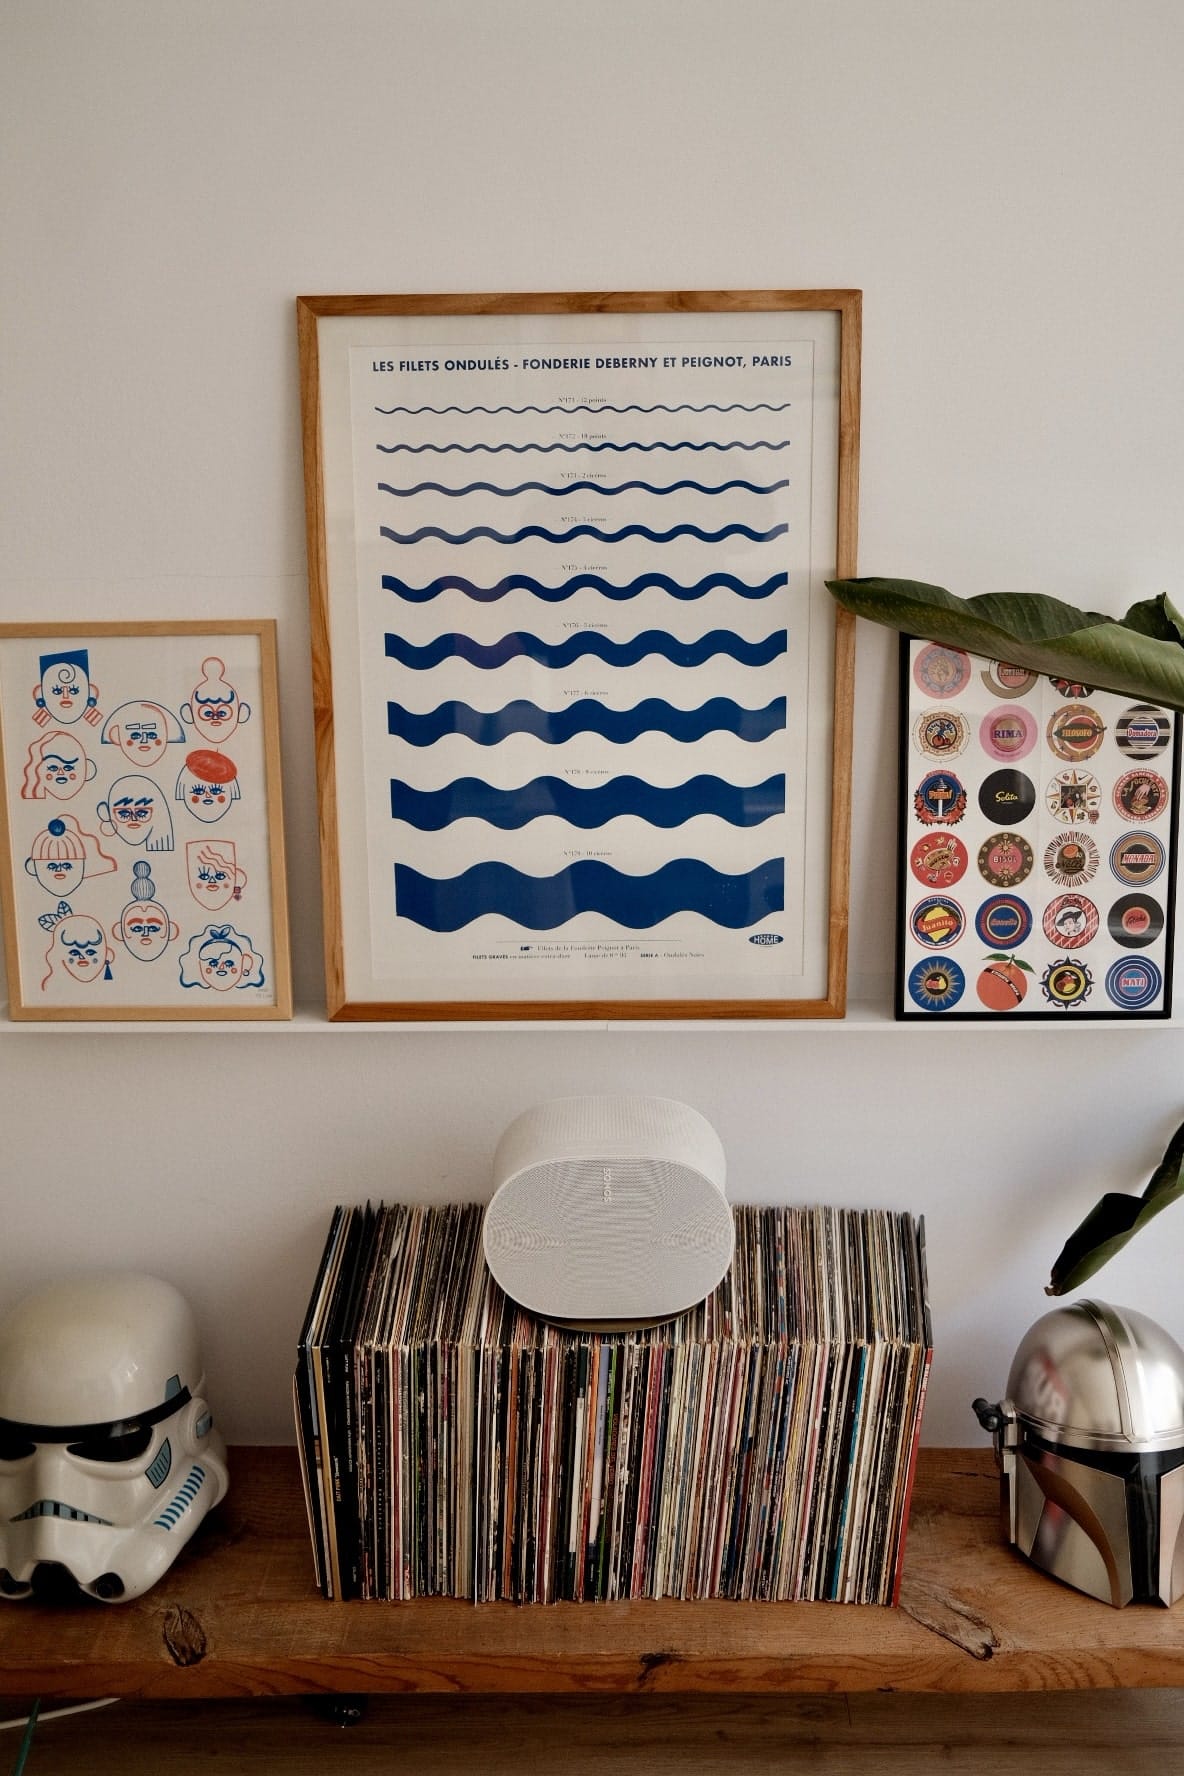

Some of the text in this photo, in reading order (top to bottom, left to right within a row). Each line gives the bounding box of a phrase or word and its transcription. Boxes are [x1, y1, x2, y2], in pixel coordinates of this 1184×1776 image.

[372, 360, 394, 372] LES
[399, 360, 440, 372] FILETS
[444, 356, 510, 371] ONDULÉS
[522, 358, 591, 370] FONDERIE
[595, 357, 658, 369] DEBERNY
[663, 357, 677, 368] ET
[682, 356, 747, 369] PEIGNOT,
[752, 355, 792, 367] PARIS
[993, 729, 1023, 738] RIMA
[1127, 727, 1158, 739] Domadora
[995, 791, 1019, 803] Solita
[921, 919, 954, 932] Juanito
[753, 935, 779, 945] HOME
